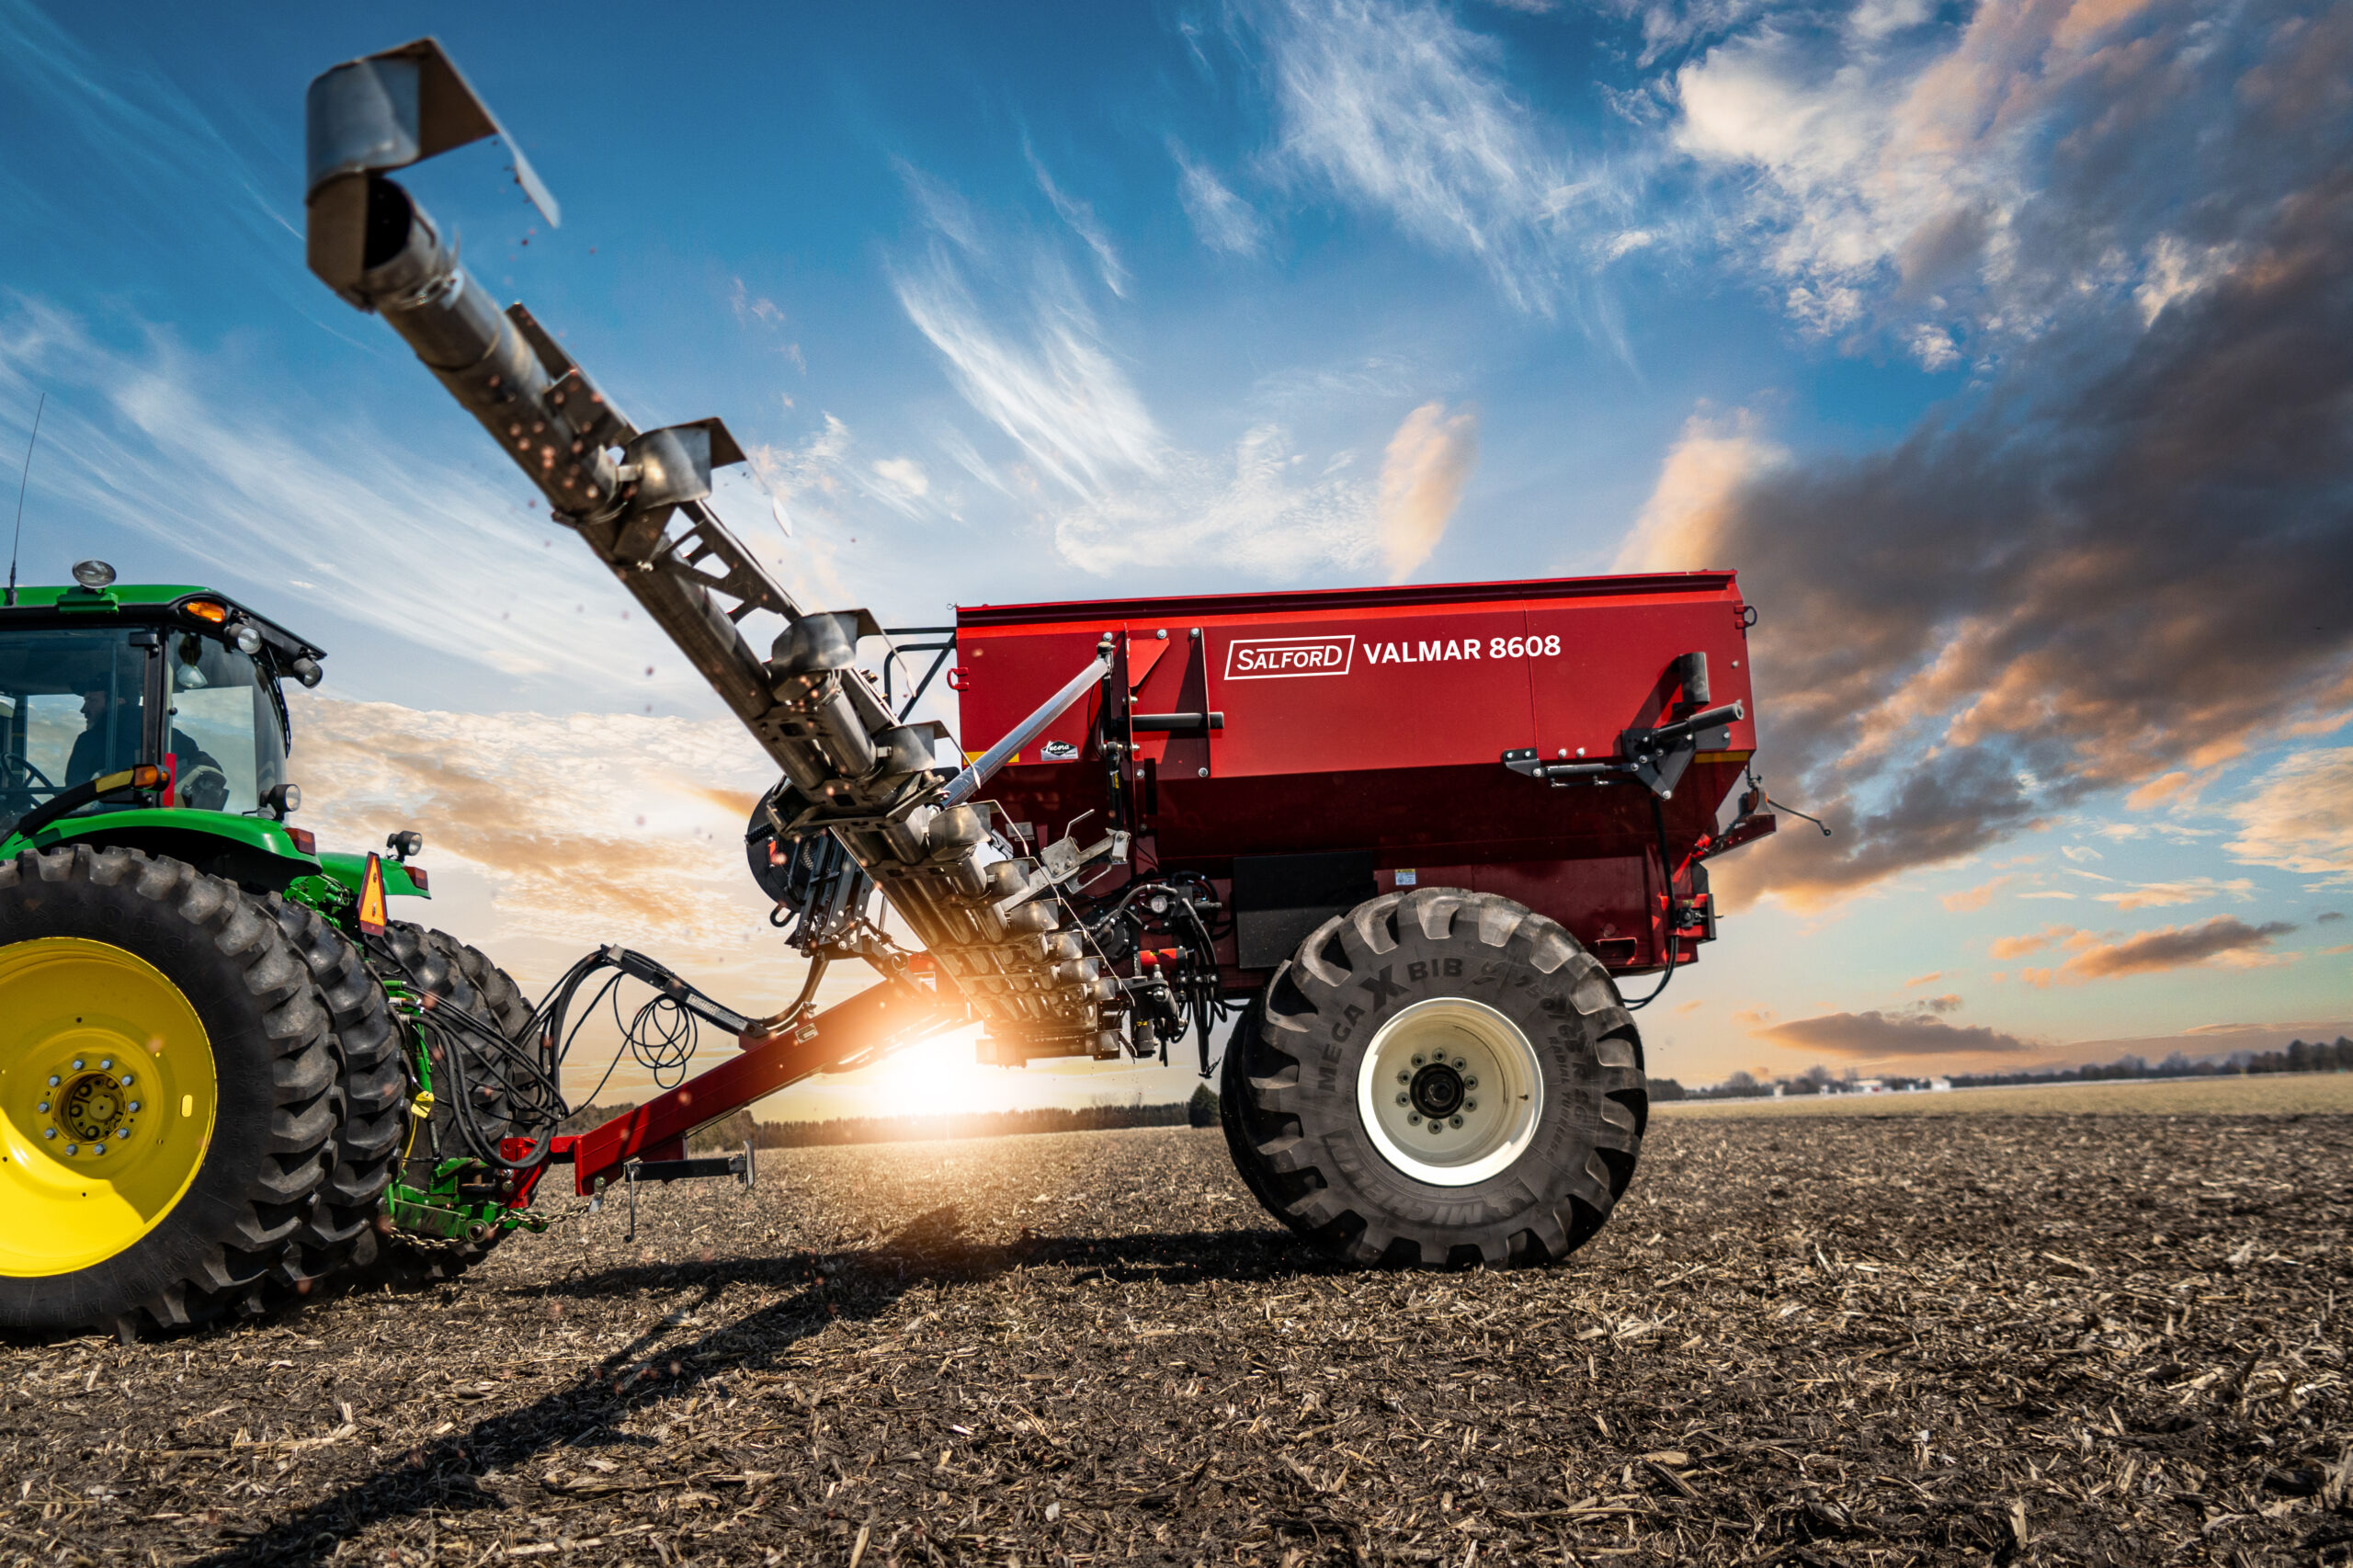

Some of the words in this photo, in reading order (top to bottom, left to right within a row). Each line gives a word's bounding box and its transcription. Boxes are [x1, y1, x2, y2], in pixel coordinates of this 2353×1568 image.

[1236, 644, 1343, 671] SALFORD
[1363, 638, 1482, 665] VALMAR
[1489, 634, 1562, 660] 8608
[1325, 1135, 1483, 1225] MICHELIN
